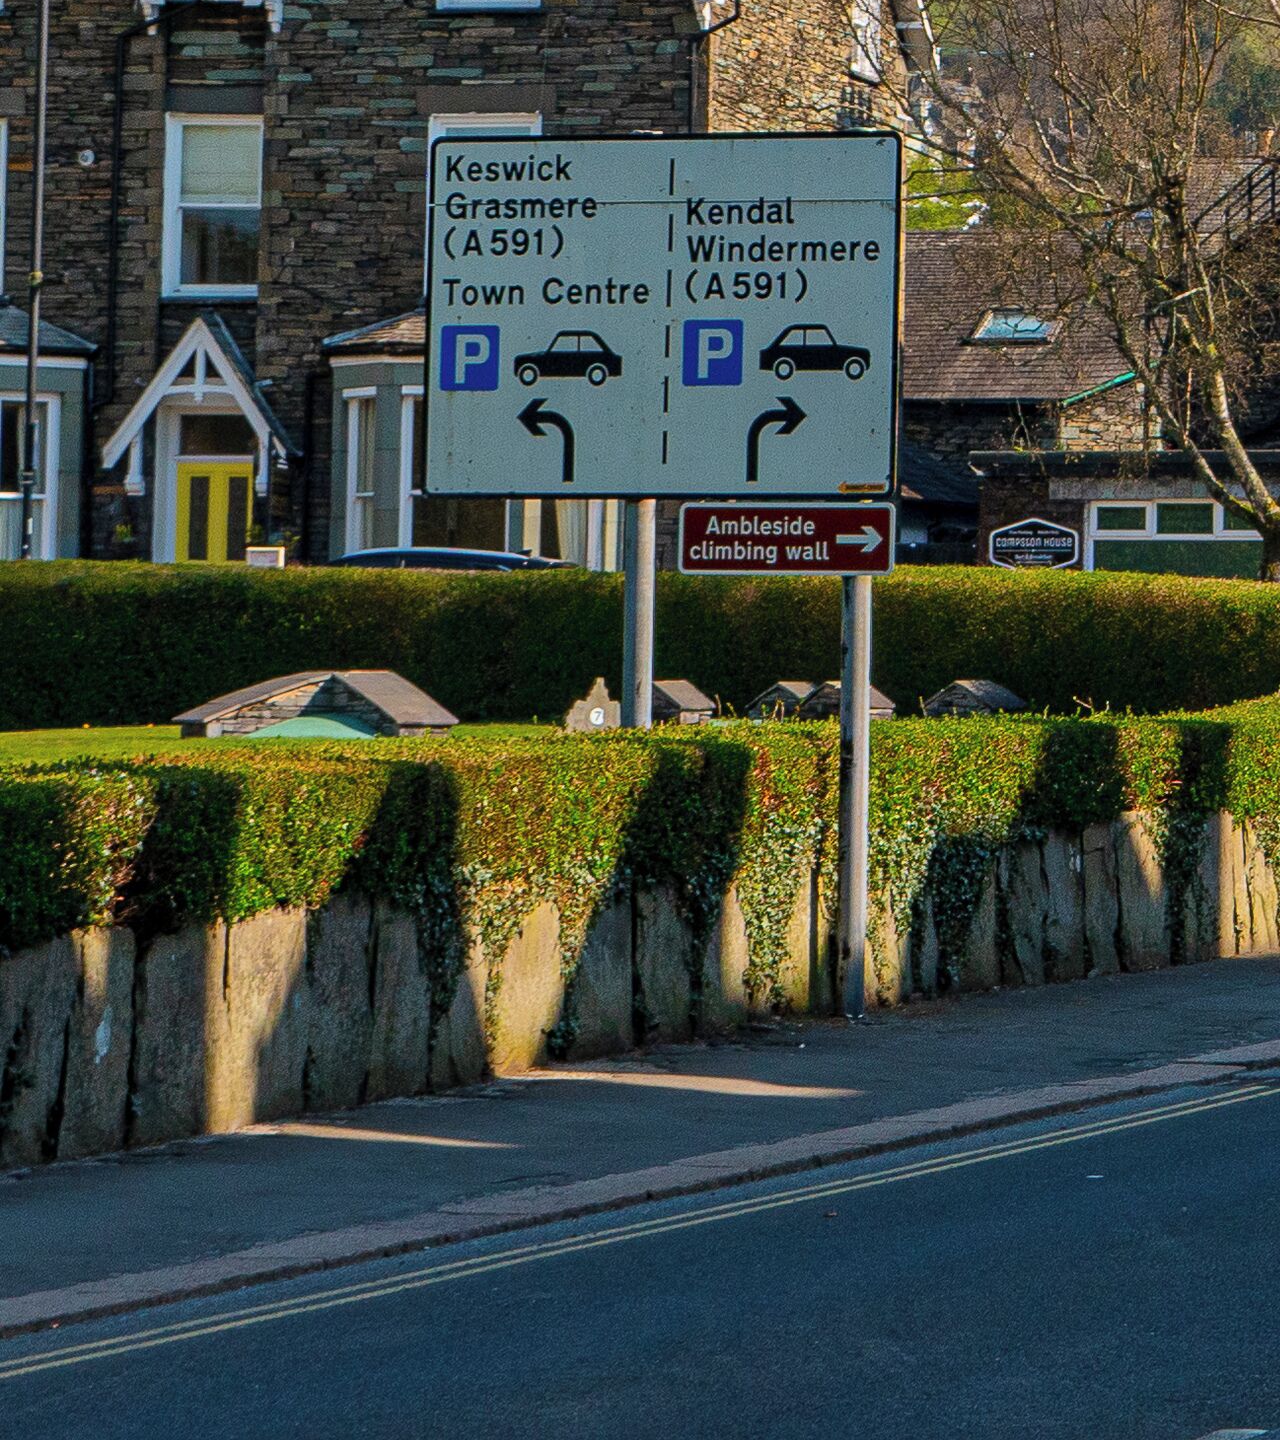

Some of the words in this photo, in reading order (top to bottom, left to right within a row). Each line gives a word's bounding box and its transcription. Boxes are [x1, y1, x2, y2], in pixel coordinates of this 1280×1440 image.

[446, 154, 572, 182] Keswick
[445, 192, 598, 219] Grasmere
[686, 197, 795, 225] Kendal
[687, 235, 881, 263] Windermere
[443, 278, 525, 307] Town
[542, 277, 650, 305] Centre
[454, 333, 490, 384] P
[697, 328, 734, 379] P
[706, 516, 815, 536] Ambleside
[690, 541, 777, 564] climbing
[785, 541, 830, 561] wall
